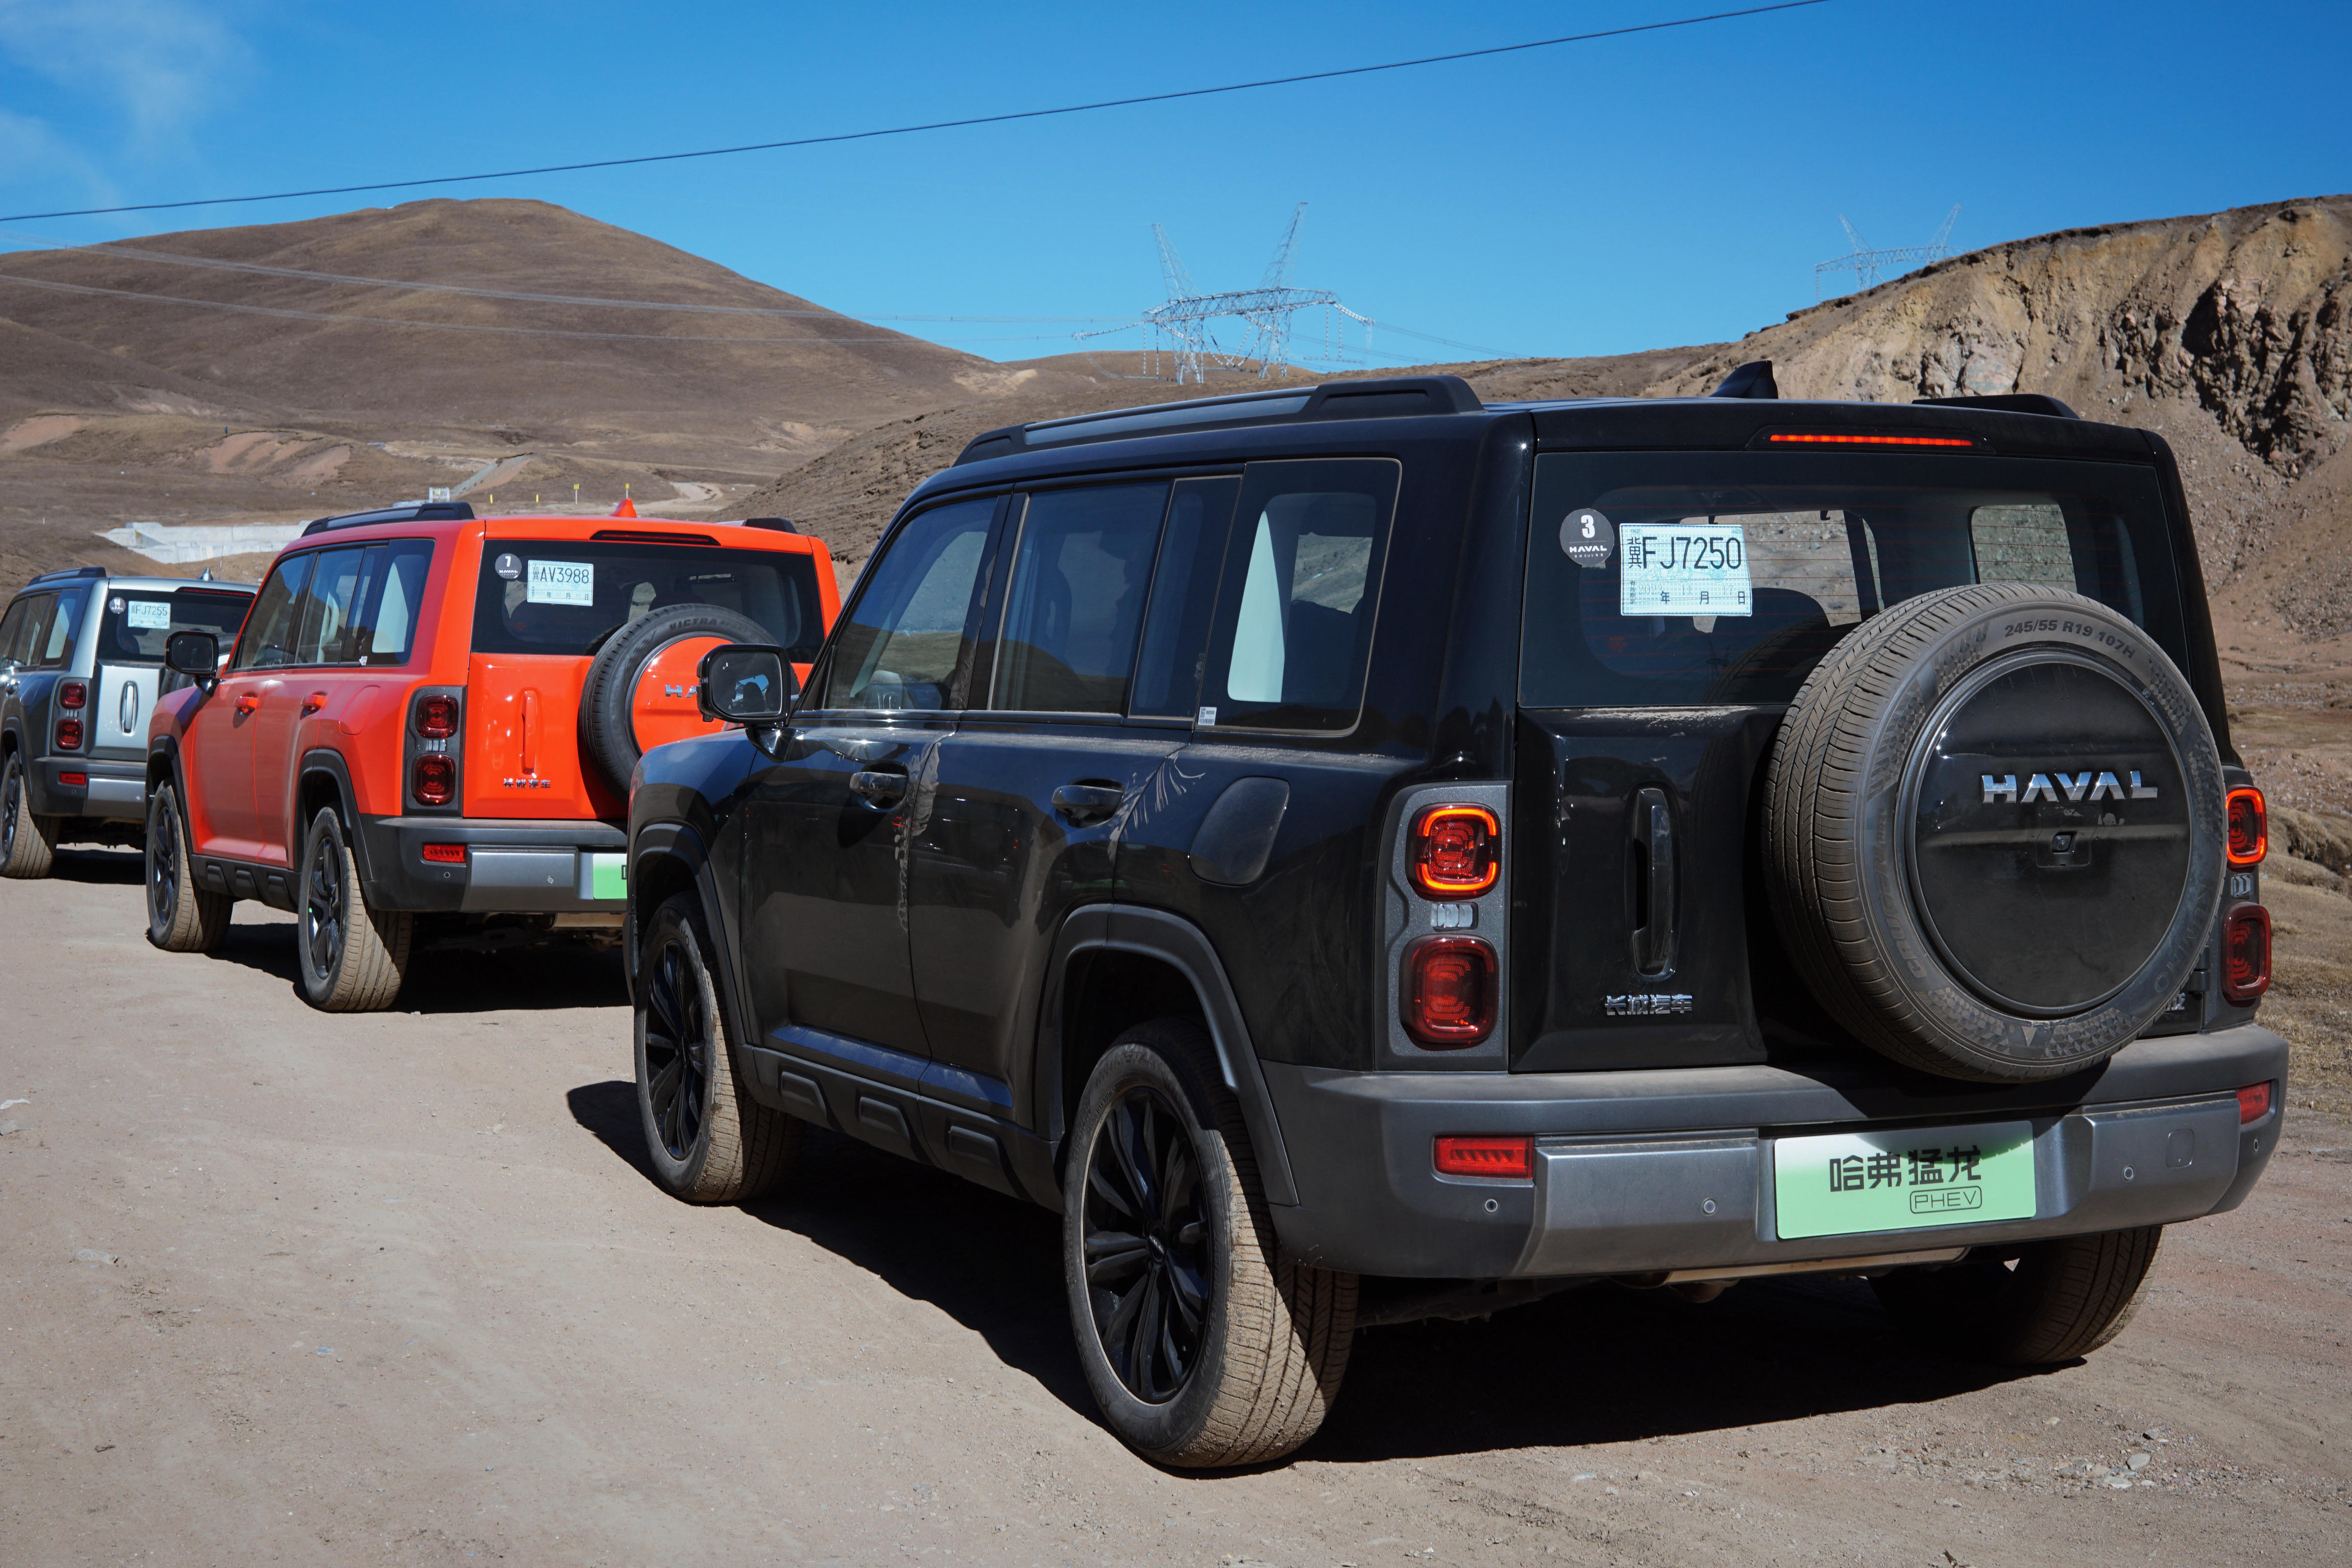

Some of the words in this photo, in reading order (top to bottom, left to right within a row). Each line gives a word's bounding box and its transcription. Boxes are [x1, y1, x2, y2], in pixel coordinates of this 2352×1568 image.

[1581, 514, 1595, 538] 3
[1569, 545, 1607, 553] HAVAL
[1627, 536, 1742, 569] 冀FJ7250
[532, 565, 589, 584] 冀AV3988
[1660, 591, 1670, 604] 年
[1699, 591, 1709, 604] 月
[1737, 591, 1746, 604] 日
[669, 618, 717, 630] VICTRA
[2004, 619, 2058, 638] 245/55
[2062, 621, 2093, 637] R19
[2098, 631, 2136, 659] 107H
[1981, 770, 2158, 804] HAVAL
[1604, 994, 1693, 1016] 长城汽车
[1829, 1145, 1981, 1192] 哈弗猛龙
[1915, 1190, 1977, 1209] PHEV
